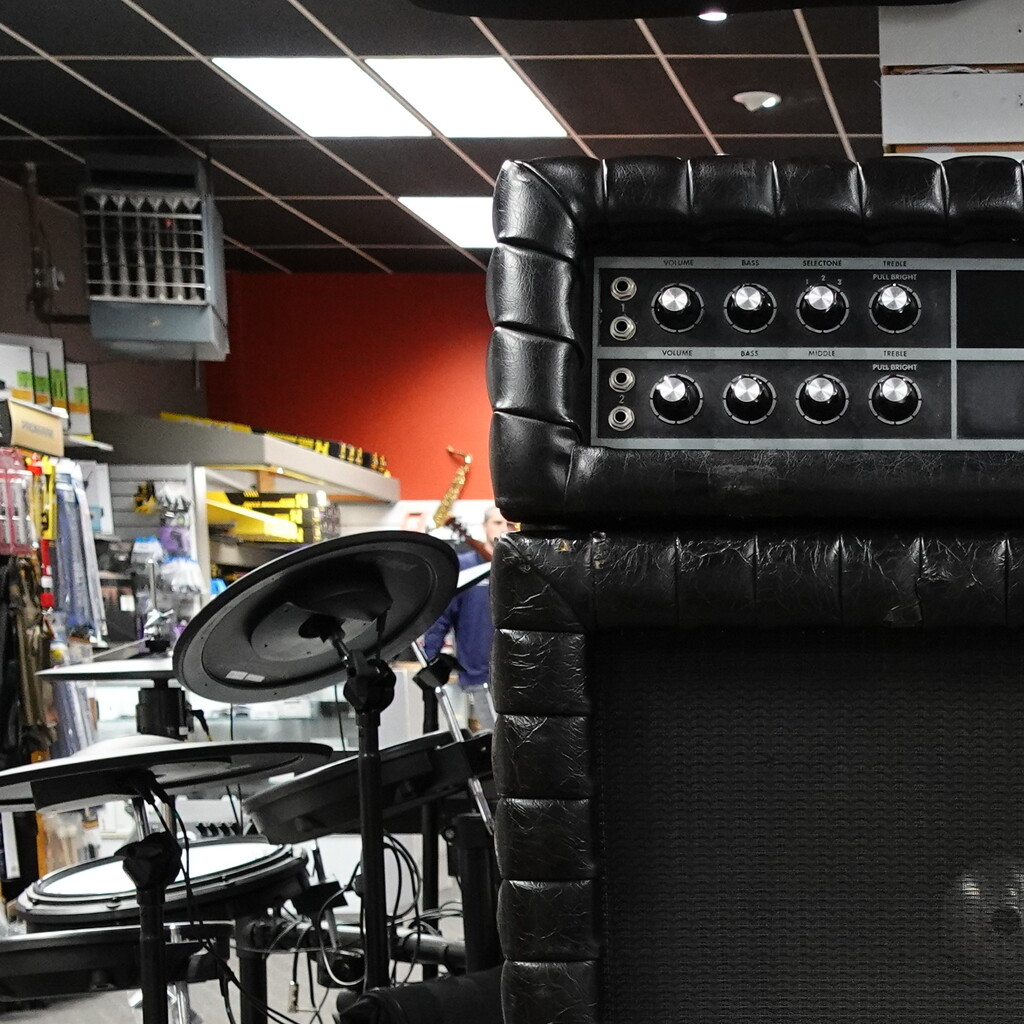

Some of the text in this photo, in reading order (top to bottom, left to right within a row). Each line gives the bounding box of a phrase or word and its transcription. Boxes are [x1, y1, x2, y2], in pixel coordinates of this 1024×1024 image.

[663, 259, 694, 267] VOLUME
[741, 259, 760, 267] BASS
[802, 259, 842, 267] SELECTONE
[890, 273, 918, 281] BRIGHT
[662, 349, 693, 357] VOLUME
[872, 363, 918, 371] PULL BRIGHT
